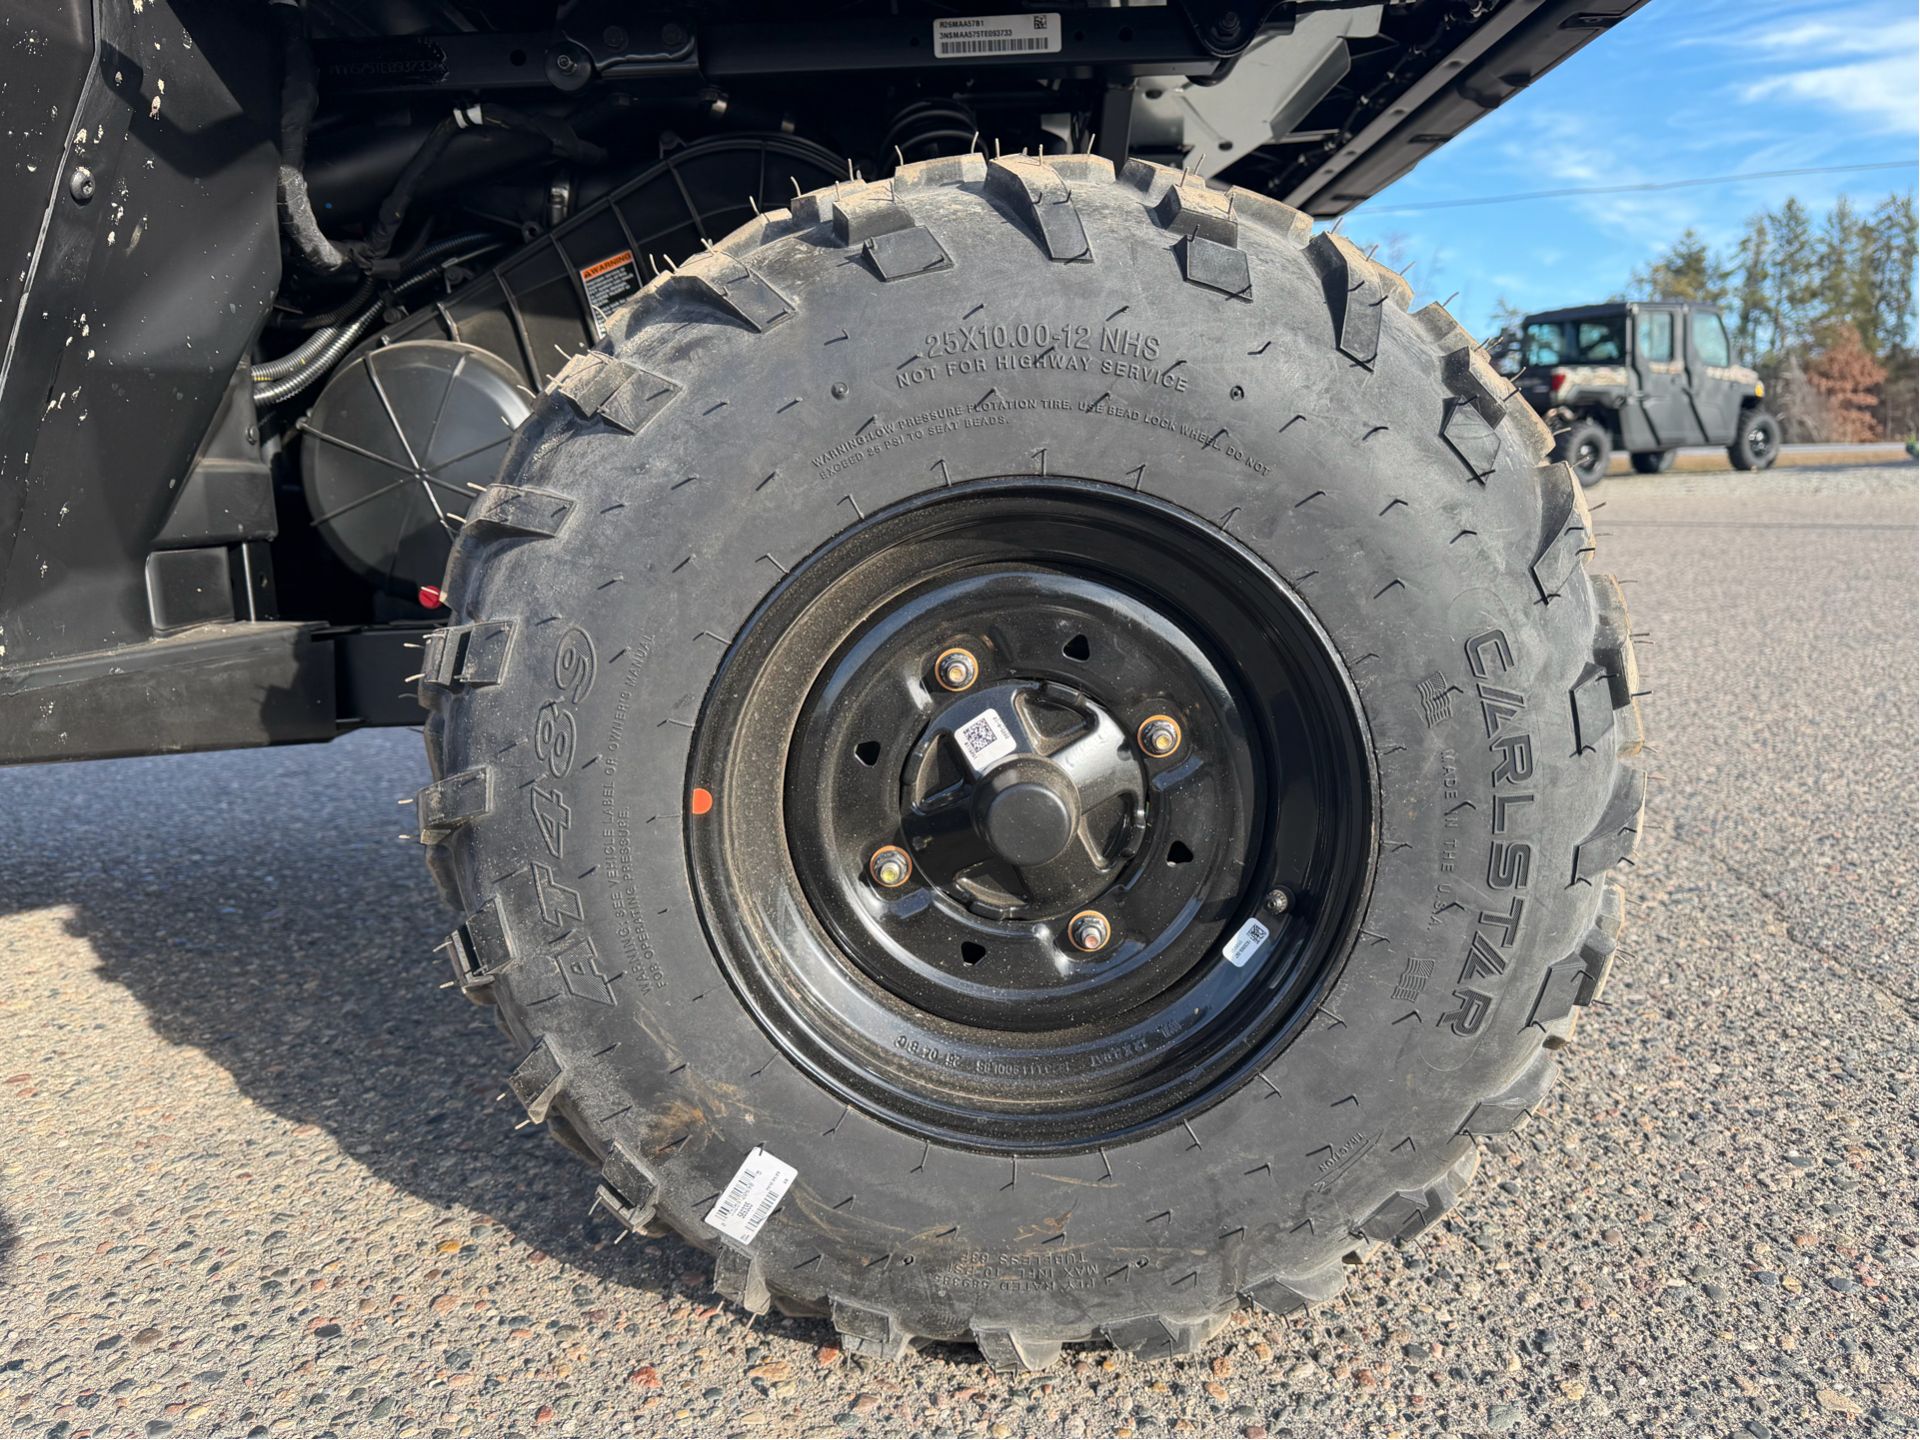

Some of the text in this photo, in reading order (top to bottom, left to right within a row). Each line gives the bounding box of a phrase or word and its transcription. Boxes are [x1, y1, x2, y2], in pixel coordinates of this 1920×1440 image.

[590, 252, 631, 275] WARNING
[925, 323, 1161, 361] 25X10.00-12 NHS
[896, 353, 1189, 392] NOT FOR HIGHWAY SERVICE
[819, 452, 865, 480] EXCEED
[884, 435, 905, 450] PSI
[907, 430, 924, 442] TO
[927, 423, 960, 437] SEAT
[898, 404, 963, 430] PRESSURE
[966, 399, 1037, 414] FLOTATION
[1077, 402, 1102, 414] USE
[1107, 405, 1140, 421] BEAD
[1143, 414, 1177, 431] LOCK
[1226, 447, 1244, 461] DO
[1246, 456, 1272, 477] NOT
[625, 634, 656, 688] MANUAL
[604, 758, 618, 777] OR
[1440, 749, 1459, 800] MADE
[602, 781, 616, 824] LABEL
[1444, 811, 1459, 829] IN
[1436, 627, 1535, 1038] CARLSTAR
[603, 829, 620, 889] VEHICLE
[1440, 839, 1459, 873] THE
[611, 891, 626, 918] SEE
[625, 886, 654, 961] OPERATING
[648, 963, 669, 990] FOR
[1318, 1131, 1365, 1173] TRACTION
[999, 1252, 1089, 1266] TUBELESS
[1063, 1264, 1099, 1279] MAX
[1000, 1280, 1056, 1291] RATED
[1065, 1277, 1096, 1290] PLY
